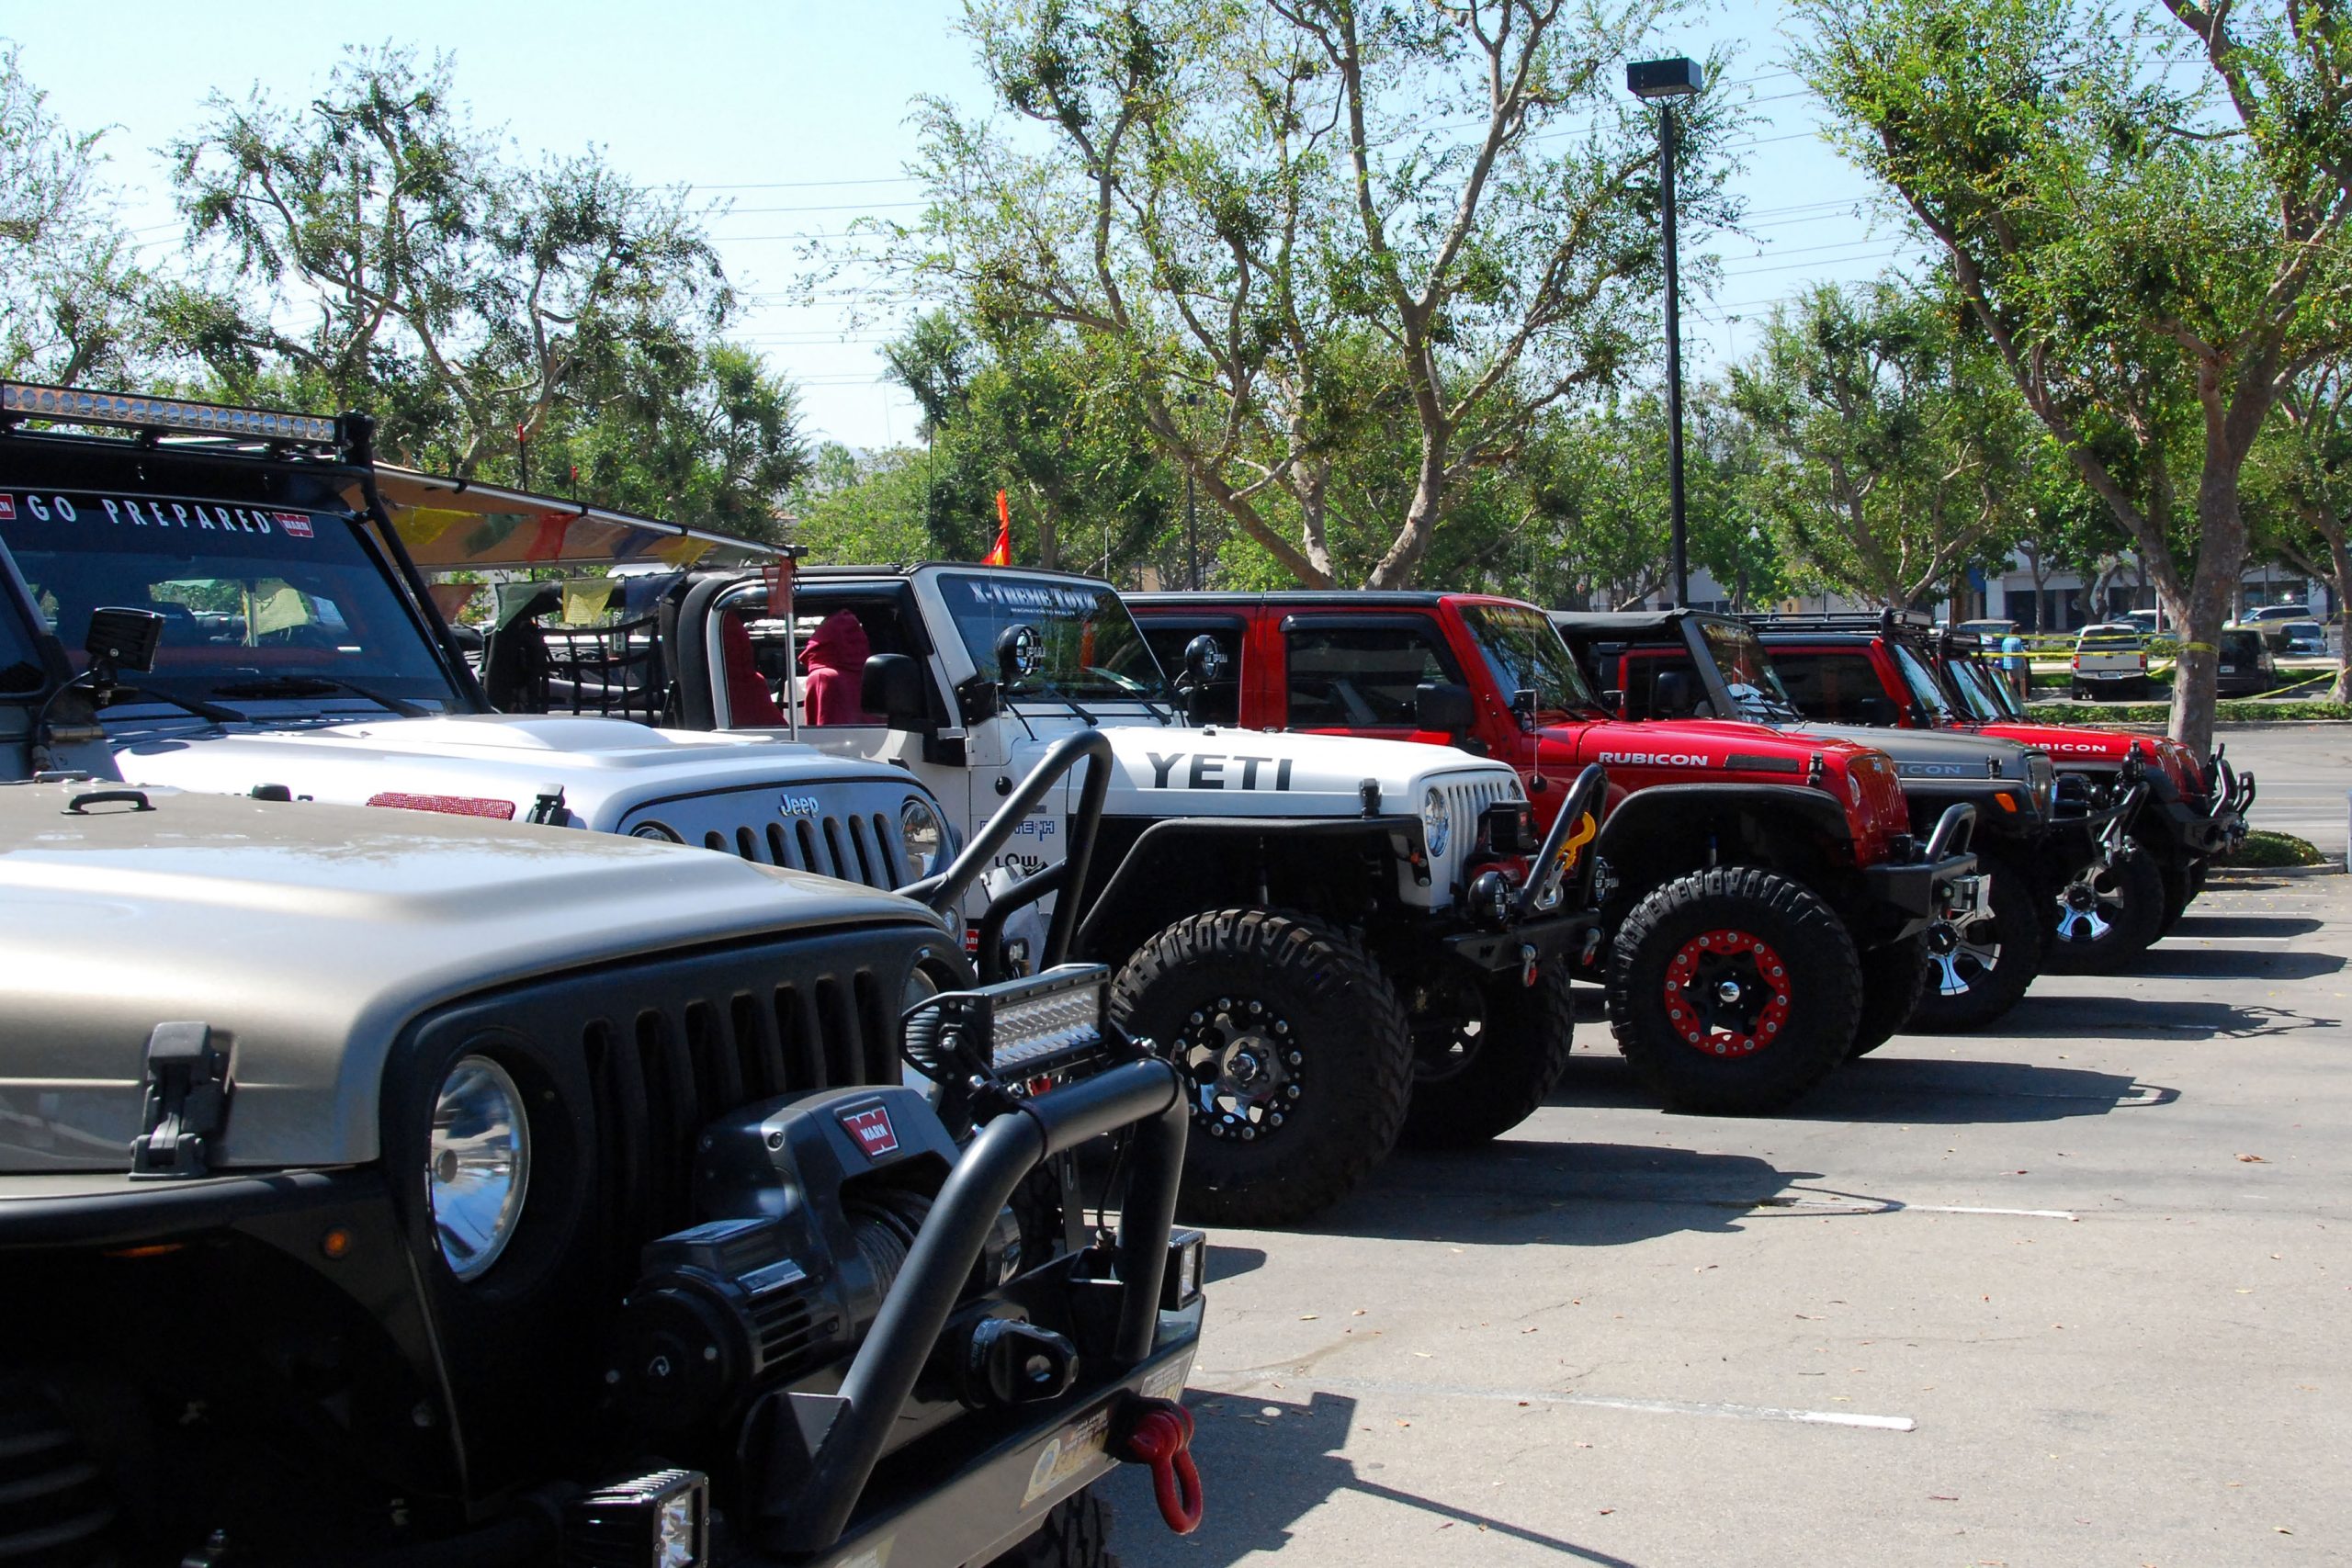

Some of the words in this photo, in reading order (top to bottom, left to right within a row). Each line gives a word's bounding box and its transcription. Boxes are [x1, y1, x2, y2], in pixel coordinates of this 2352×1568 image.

[27, 494, 77, 522] GO
[101, 499, 271, 534] PREPARED
[281, 518, 311, 531] WARN
[2031, 743, 2107, 752] BICON
[1599, 751, 1709, 766] RUBICON
[1145, 751, 1294, 792] YETI
[1899, 764, 1962, 774] ICON
[779, 794, 820, 818] Jeep
[859, 1122, 888, 1142] WARN
